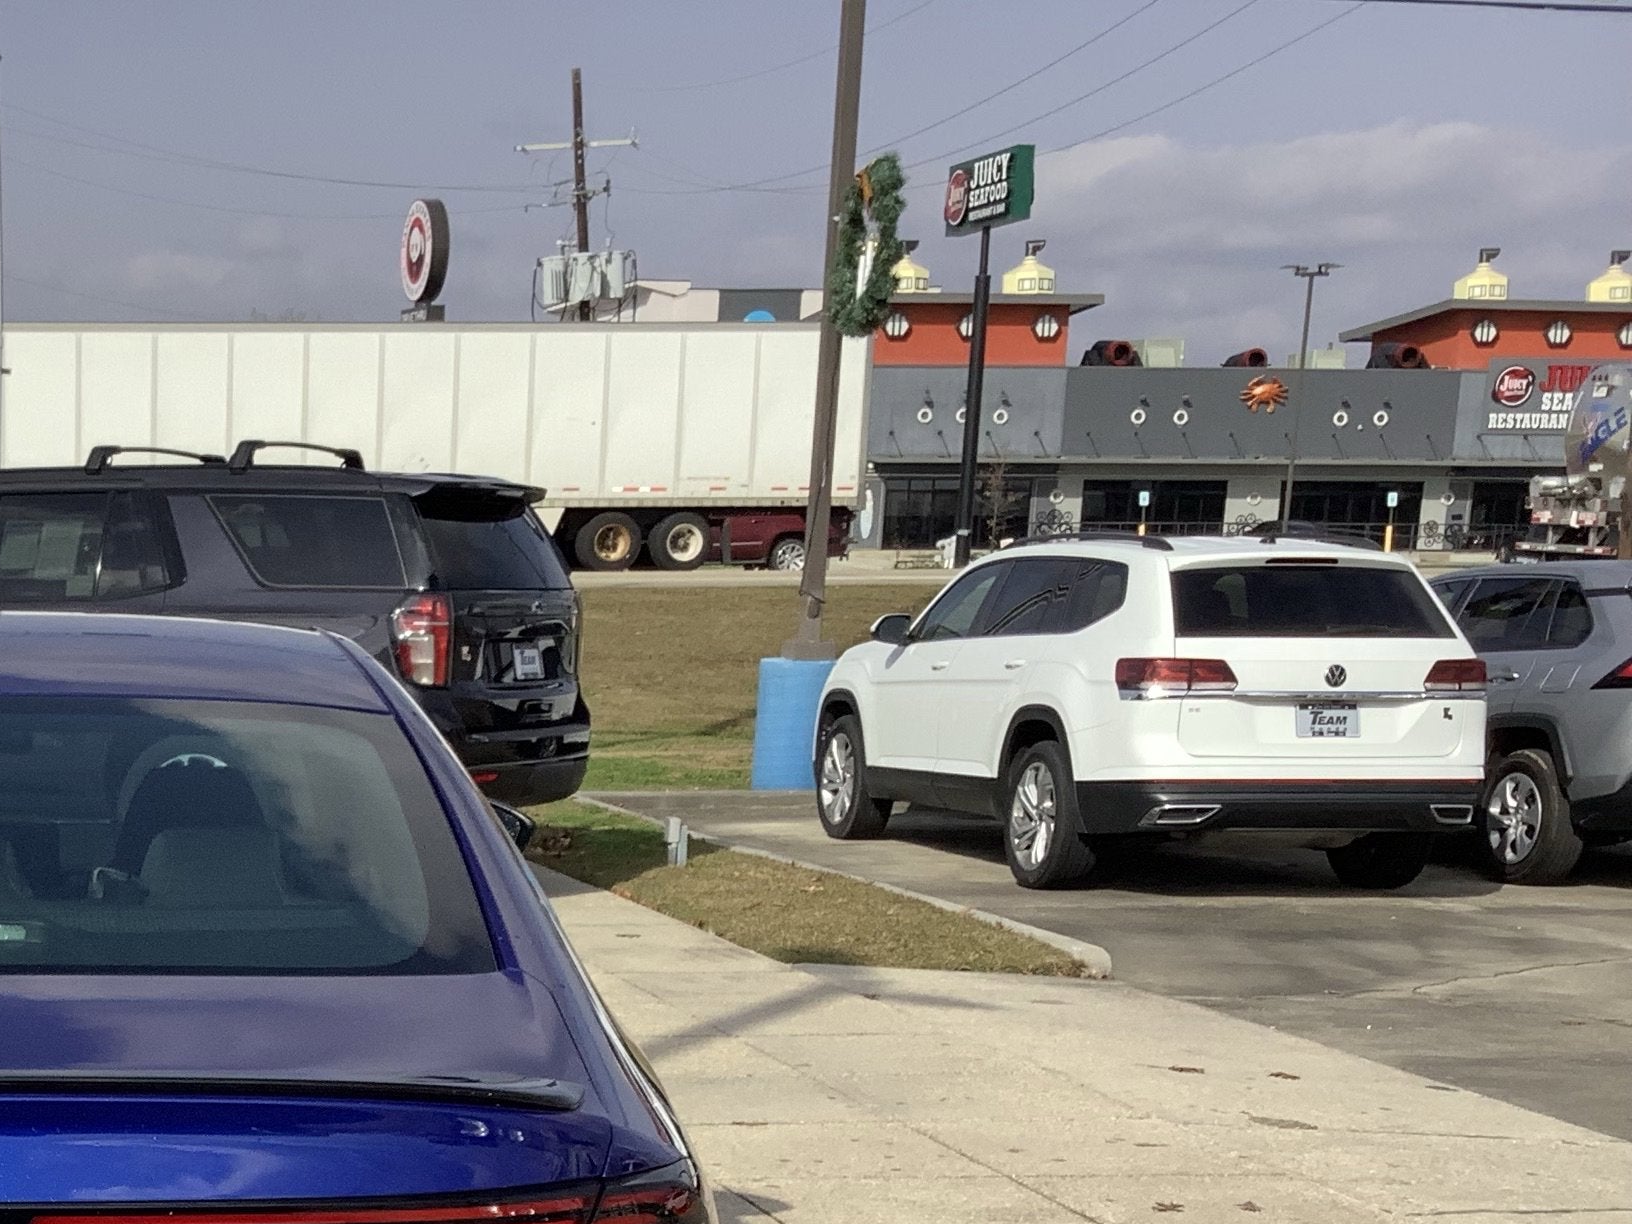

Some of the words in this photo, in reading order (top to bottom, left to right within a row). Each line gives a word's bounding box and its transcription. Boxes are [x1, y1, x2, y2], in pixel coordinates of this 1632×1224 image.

[970, 153, 1011, 189] JUICY
[969, 181, 1008, 208] SEAFOOD
[1310, 711, 1348, 725] TEAM
